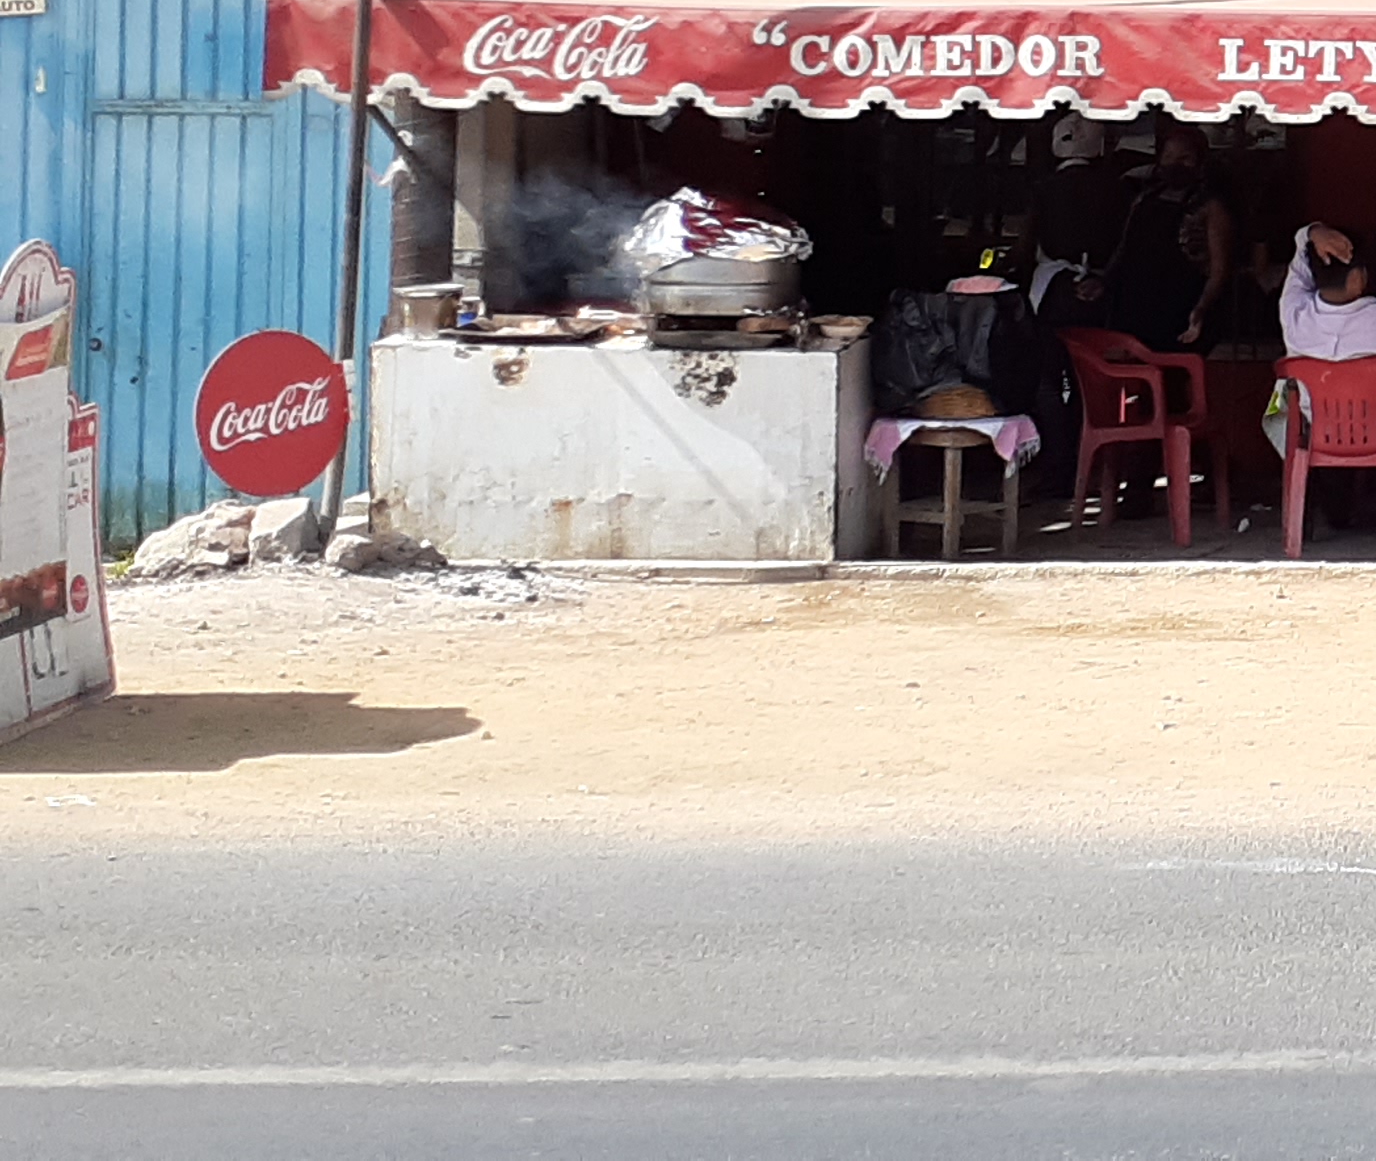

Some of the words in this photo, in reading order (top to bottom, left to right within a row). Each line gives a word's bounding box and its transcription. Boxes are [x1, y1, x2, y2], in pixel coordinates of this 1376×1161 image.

[0, 0, 35, 12] UTO
[462, 13, 660, 81] Coca-Cola
[209, 375, 332, 452] Coca-Cola
